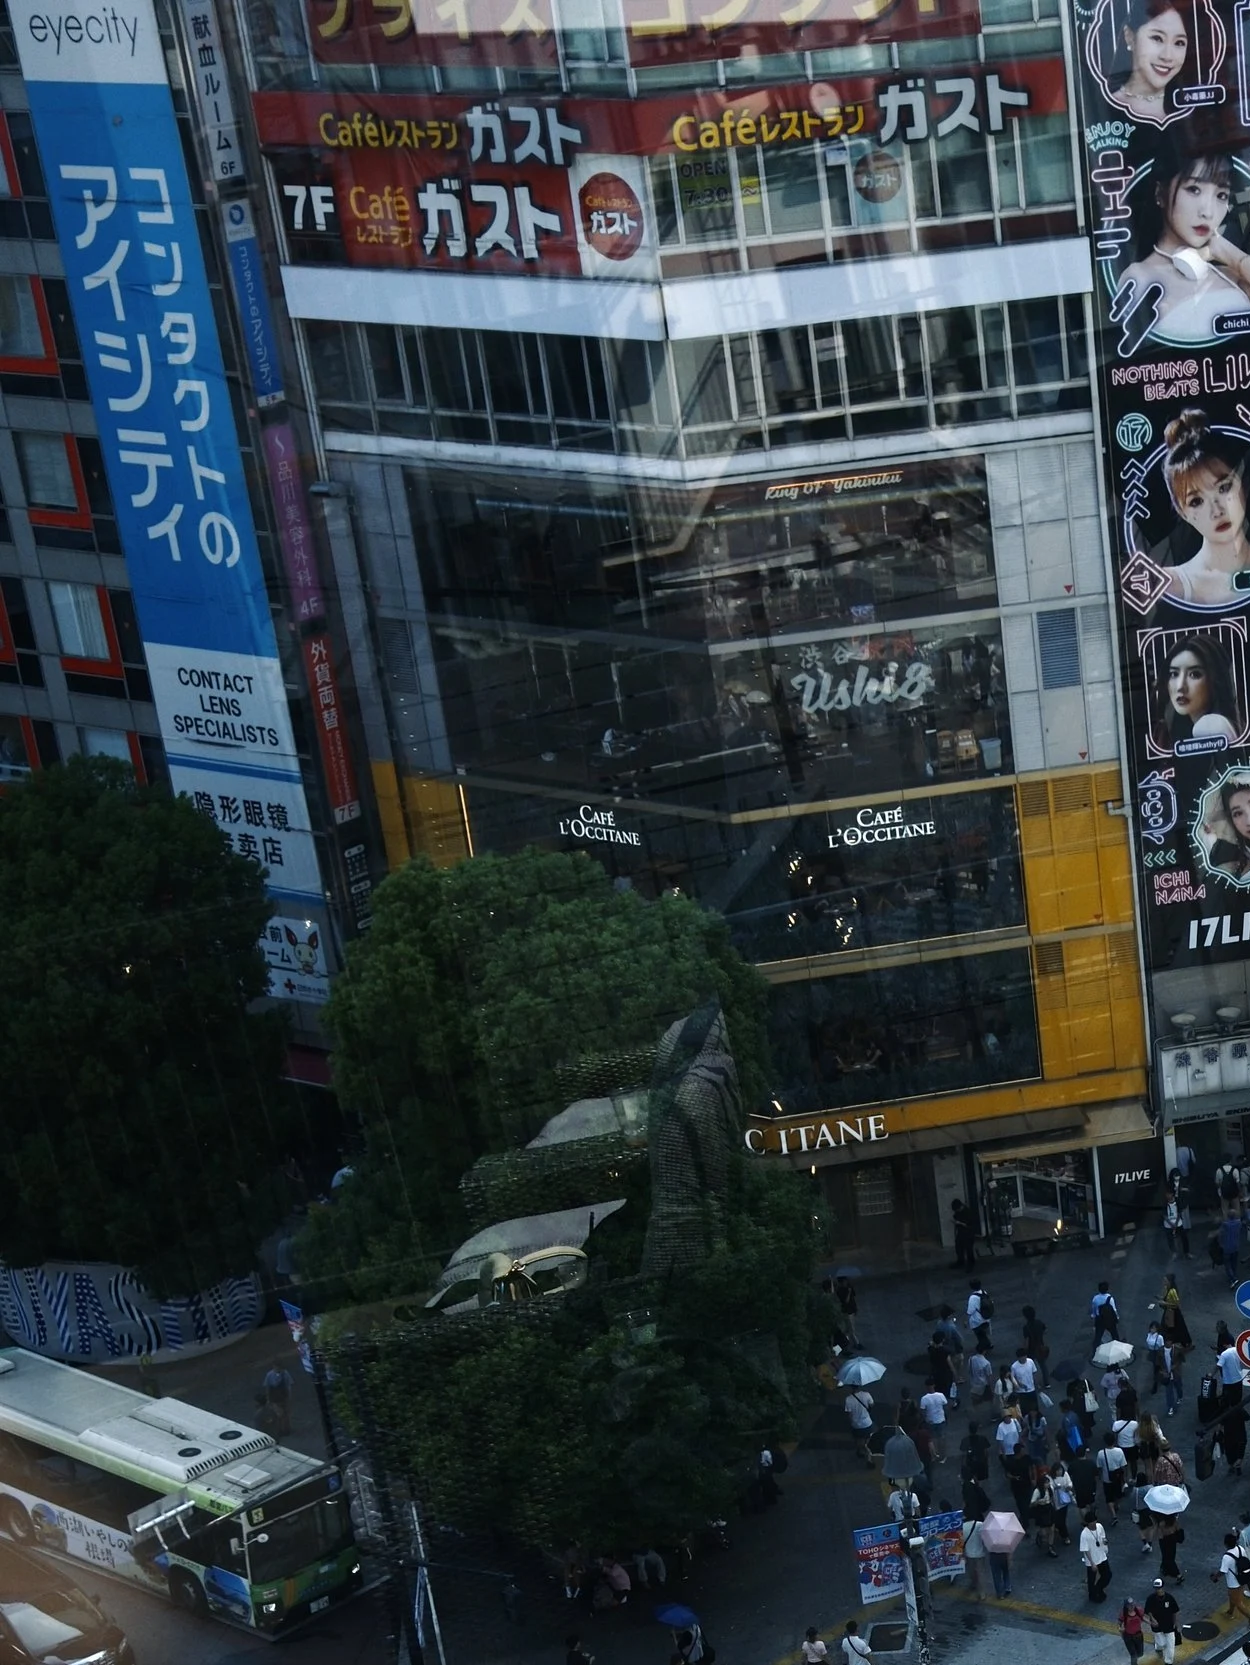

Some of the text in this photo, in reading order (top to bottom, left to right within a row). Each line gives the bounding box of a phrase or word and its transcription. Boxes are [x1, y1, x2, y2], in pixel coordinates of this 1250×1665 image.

[28, 7, 138, 57] eyecity
[191, 14, 232, 152] 献血ルーム
[878, 73, 1029, 143] ガスト
[466, 101, 583, 165] ガスト
[1084, 120, 1137, 144] ENJOY
[1089, 137, 1130, 152] TALKING
[220, 160, 236, 176] 6F
[679, 159, 729, 180] OPEN
[283, 183, 335, 232] 7F
[350, 185, 411, 222] Café
[416, 177, 561, 260] ガスト
[590, 210, 638, 236] ガスト
[59, 163, 184, 563] アイシティ
[129, 165, 242, 569] コンタクトの
[1111, 359, 1200, 387] NOTHING
[1143, 379, 1201, 402] BEATS
[1119, 420, 1147, 450] 17
[764, 486, 798, 501] King
[300, 596, 319, 617] 4F
[177, 665, 254, 696] CONTACT
[309, 640, 339, 732] 外貨両替
[199, 693, 242, 719] LENS
[173, 714, 280, 748] SPECIALISTS
[338, 805, 356, 823] 7F
[1153, 870, 1191, 890] ICHI
[1155, 884, 1207, 906] NANA
[1114, 1169, 1151, 1185] 17LIVE
